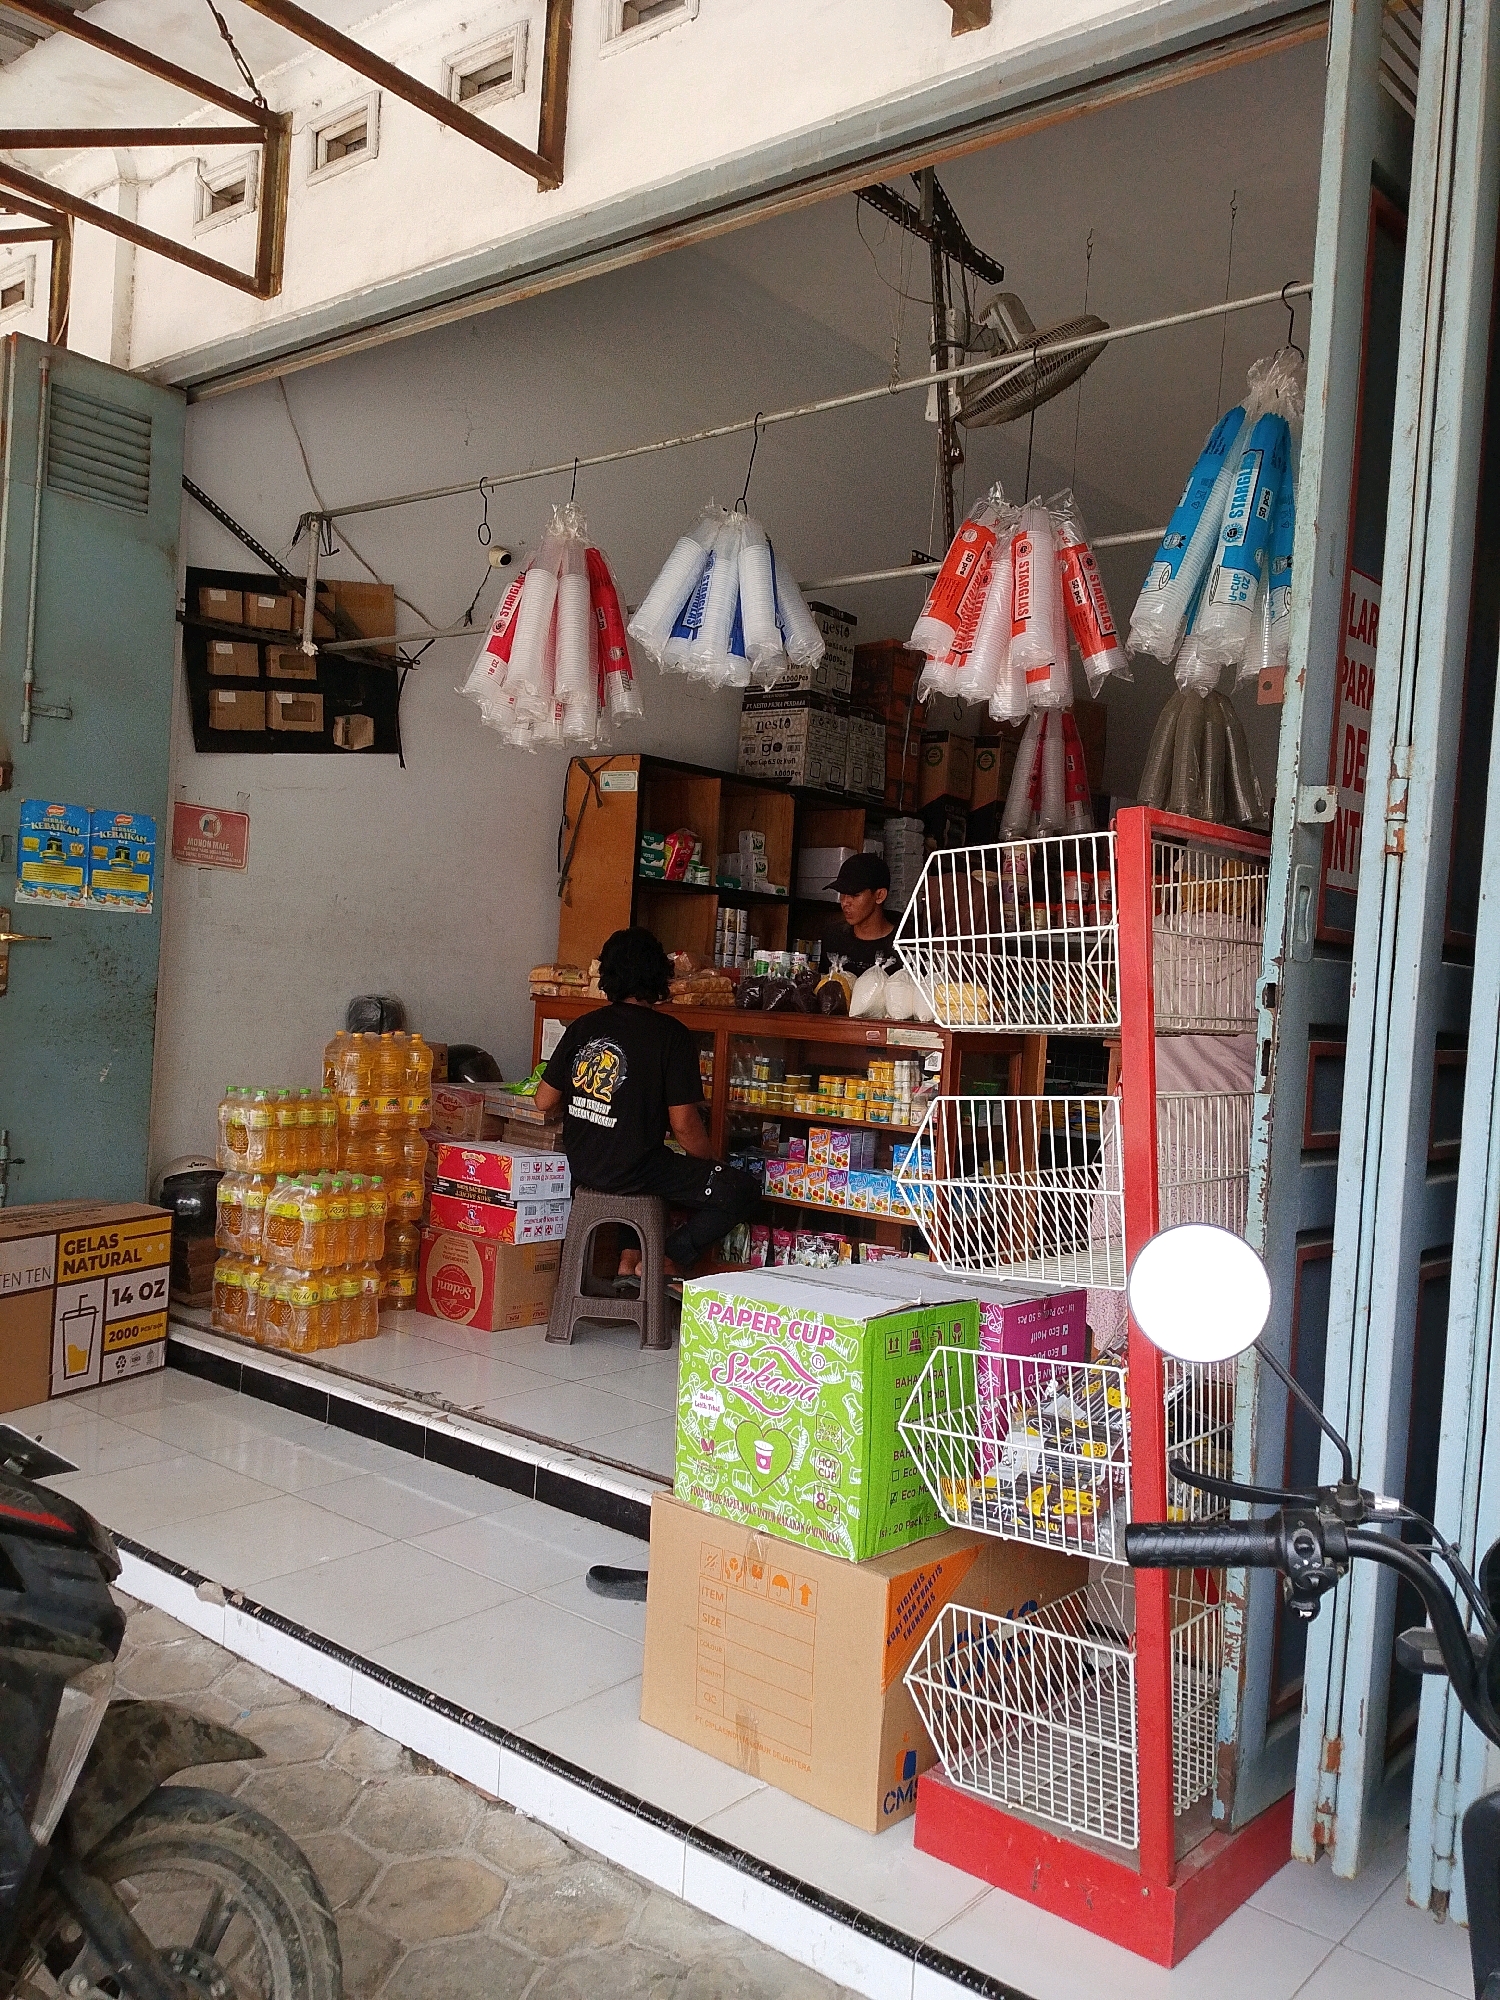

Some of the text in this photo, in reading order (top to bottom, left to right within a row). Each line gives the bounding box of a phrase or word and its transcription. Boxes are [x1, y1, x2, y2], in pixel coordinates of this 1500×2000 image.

[1258, 508, 1267, 519] 50
[964, 552, 974, 563] 50
[1018, 561, 1030, 617] STARGLAS
[1228, 573, 1240, 601] U-CUP
[1241, 577, 1251, 591] OZ
[1090, 574, 1114, 631] STARGLAS
[491, 659, 500, 668] OZ
[756, 717, 791, 733] nesto
[63, 1233, 119, 1256] GELAS
[63, 1249, 142, 1276] NATURAL
[26, 1266, 52, 1283] TEN
[111, 1279, 166, 1307] 14 OZ
[437, 1279, 472, 1300] Sedani
[707, 1302, 835, 1346] PAPER CUP
[1028, 1312, 1037, 1322] 50
[109, 1325, 139, 1344] 2000
[912, 1329, 919, 1338] 10
[1048, 1326, 1060, 1337] Eco
[1047, 1347, 1059, 1357] Eco
[711, 1352, 820, 1403] Sukawa
[818, 1456, 837, 1468] HOT
[818, 1468, 837, 1480] CUP
[903, 1467, 918, 1478] Eco
[901, 1489, 916, 1500] Eco
[893, 1523, 904, 1534] 20
[905, 1516, 923, 1529] Pack
[701, 1586, 724, 1602] ITEM
[896, 1573, 925, 1616] HIGIENIS
[887, 1620, 903, 1647] KUAT
[916, 1564, 943, 1604] PRAKTIS
[702, 1613, 722, 1628] SIZE
[903, 1592, 936, 1641] EKONOMIS
[772, 1749, 812, 1773] SEJAHTERA
